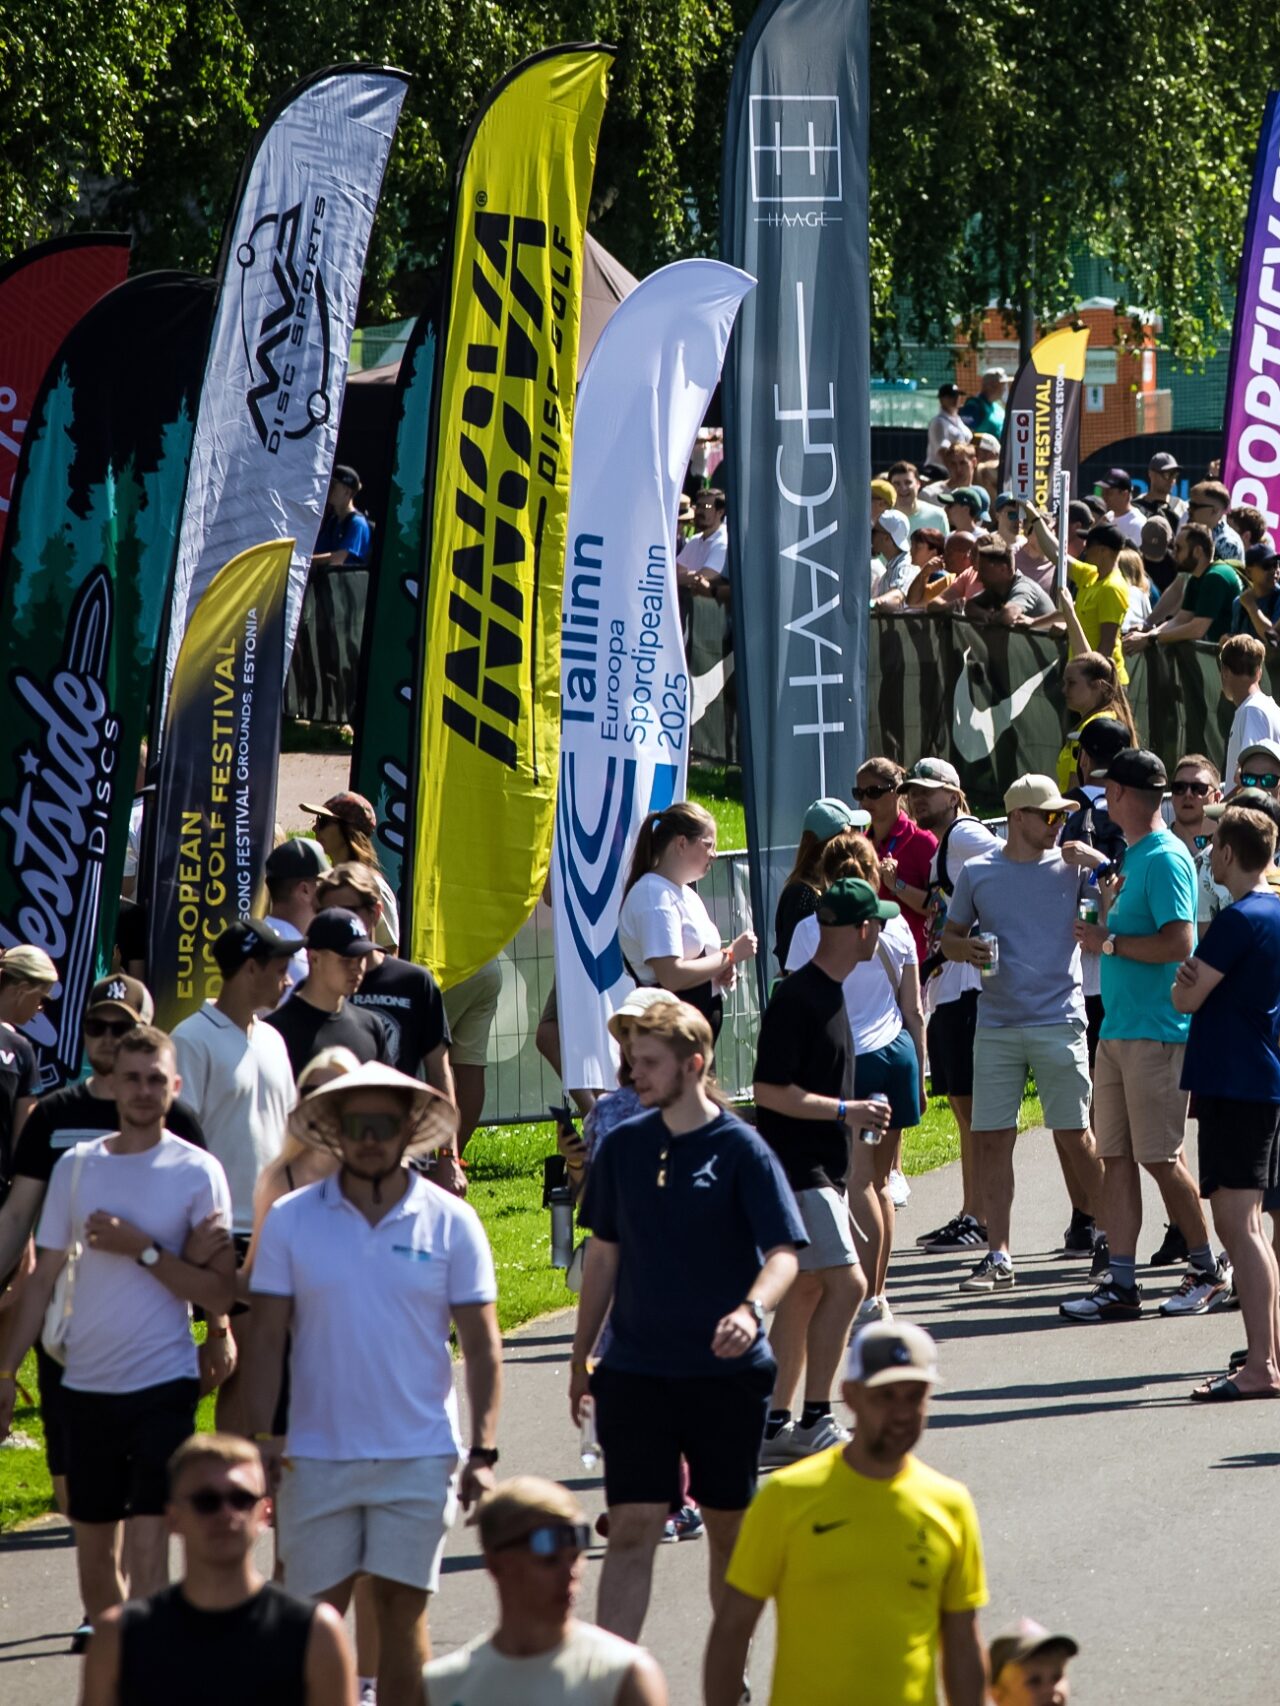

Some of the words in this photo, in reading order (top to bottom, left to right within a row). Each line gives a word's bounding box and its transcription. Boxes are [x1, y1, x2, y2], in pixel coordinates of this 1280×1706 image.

[268, 363, 296, 455] DISC
[291, 195, 326, 348] SPORTS
[537, 366, 562, 487] DISC
[550, 225, 573, 354] GOLF
[443, 211, 546, 772] INNOVA
[1016, 413, 1030, 493] QUIET
[1035, 379, 1052, 466] FESTIVAL
[774, 382, 844, 736] HAAGE
[244, 607, 258, 685] ESTONIA
[561, 532, 604, 735] Tallinn
[601, 618, 625, 741] Euroopa
[624, 543, 667, 745] Spordipealinn
[211, 637, 237, 801] FESTIVAL
[658, 672, 688, 750] 2025
[88, 717, 119, 855] DISCS
[237, 785, 251, 866] FESTIVAL
[177, 811, 203, 999] EUROPEAN
[205, 812, 228, 906] GOLF
[238, 869, 251, 920] SONG
